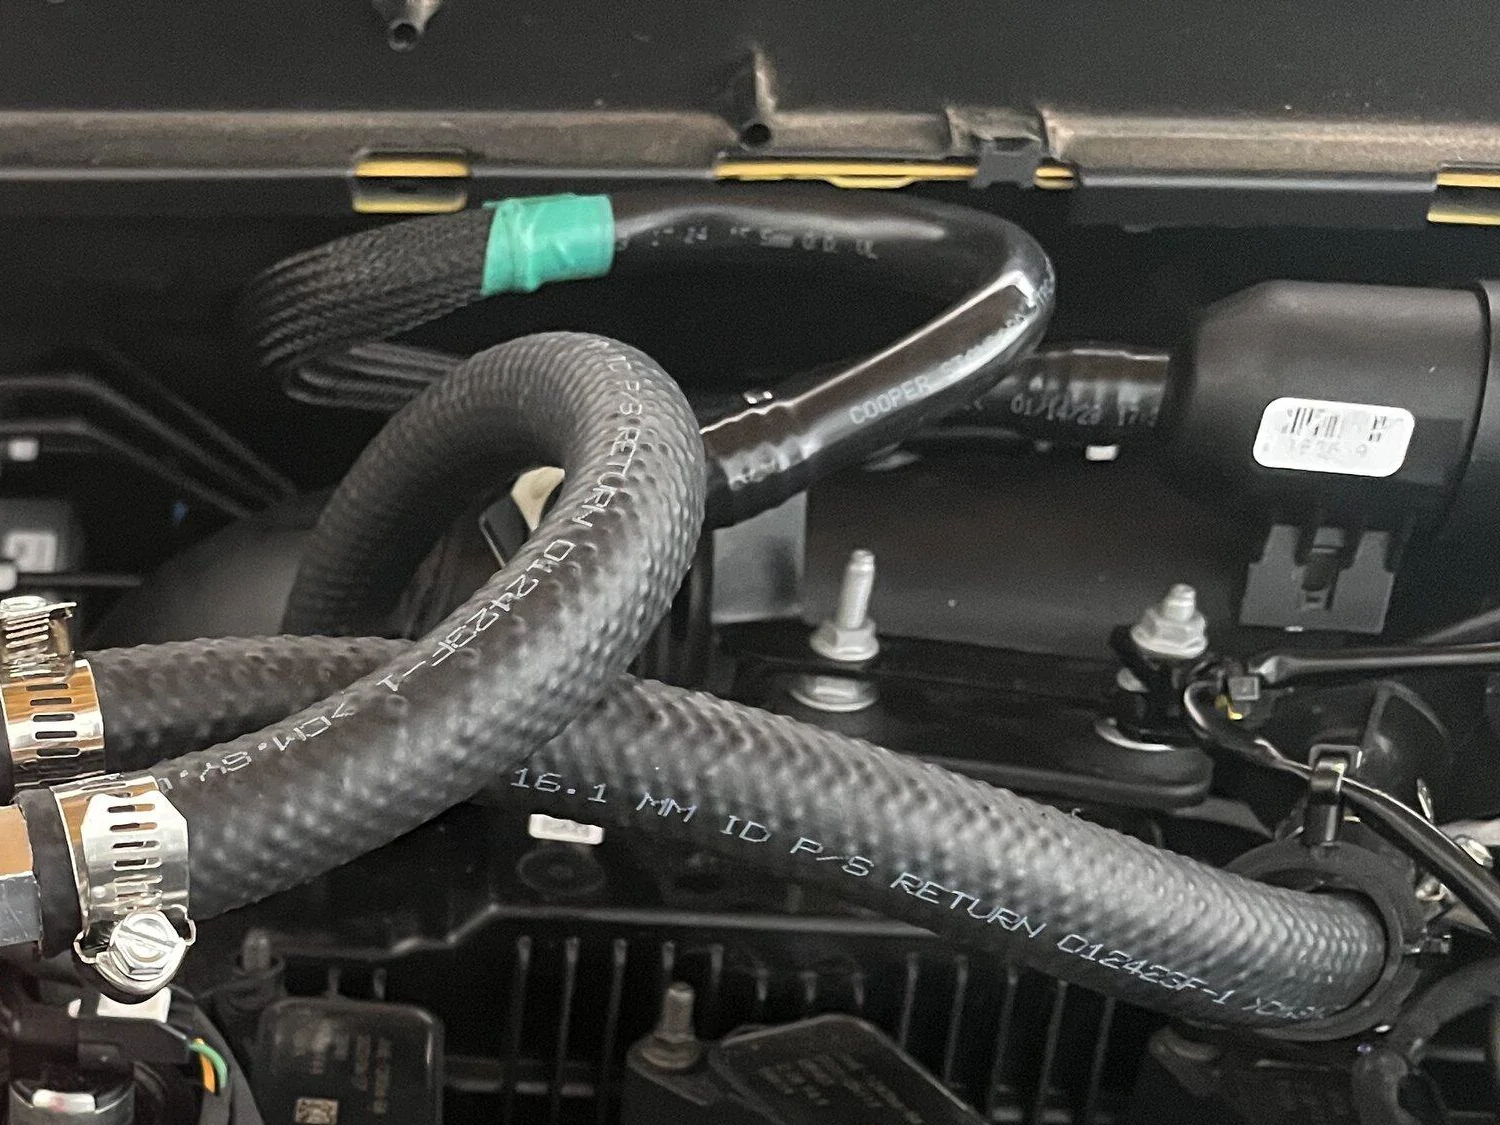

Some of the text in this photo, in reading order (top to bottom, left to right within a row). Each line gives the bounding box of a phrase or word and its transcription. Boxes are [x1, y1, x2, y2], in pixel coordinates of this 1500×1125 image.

[572, 426, 641, 527] RETURN
[510, 767, 607, 803] 16.1
[636, 792, 698, 823] MM
[720, 815, 772, 843] ID
[789, 837, 875, 877] P/S
[890, 872, 1047, 939] RETURN
